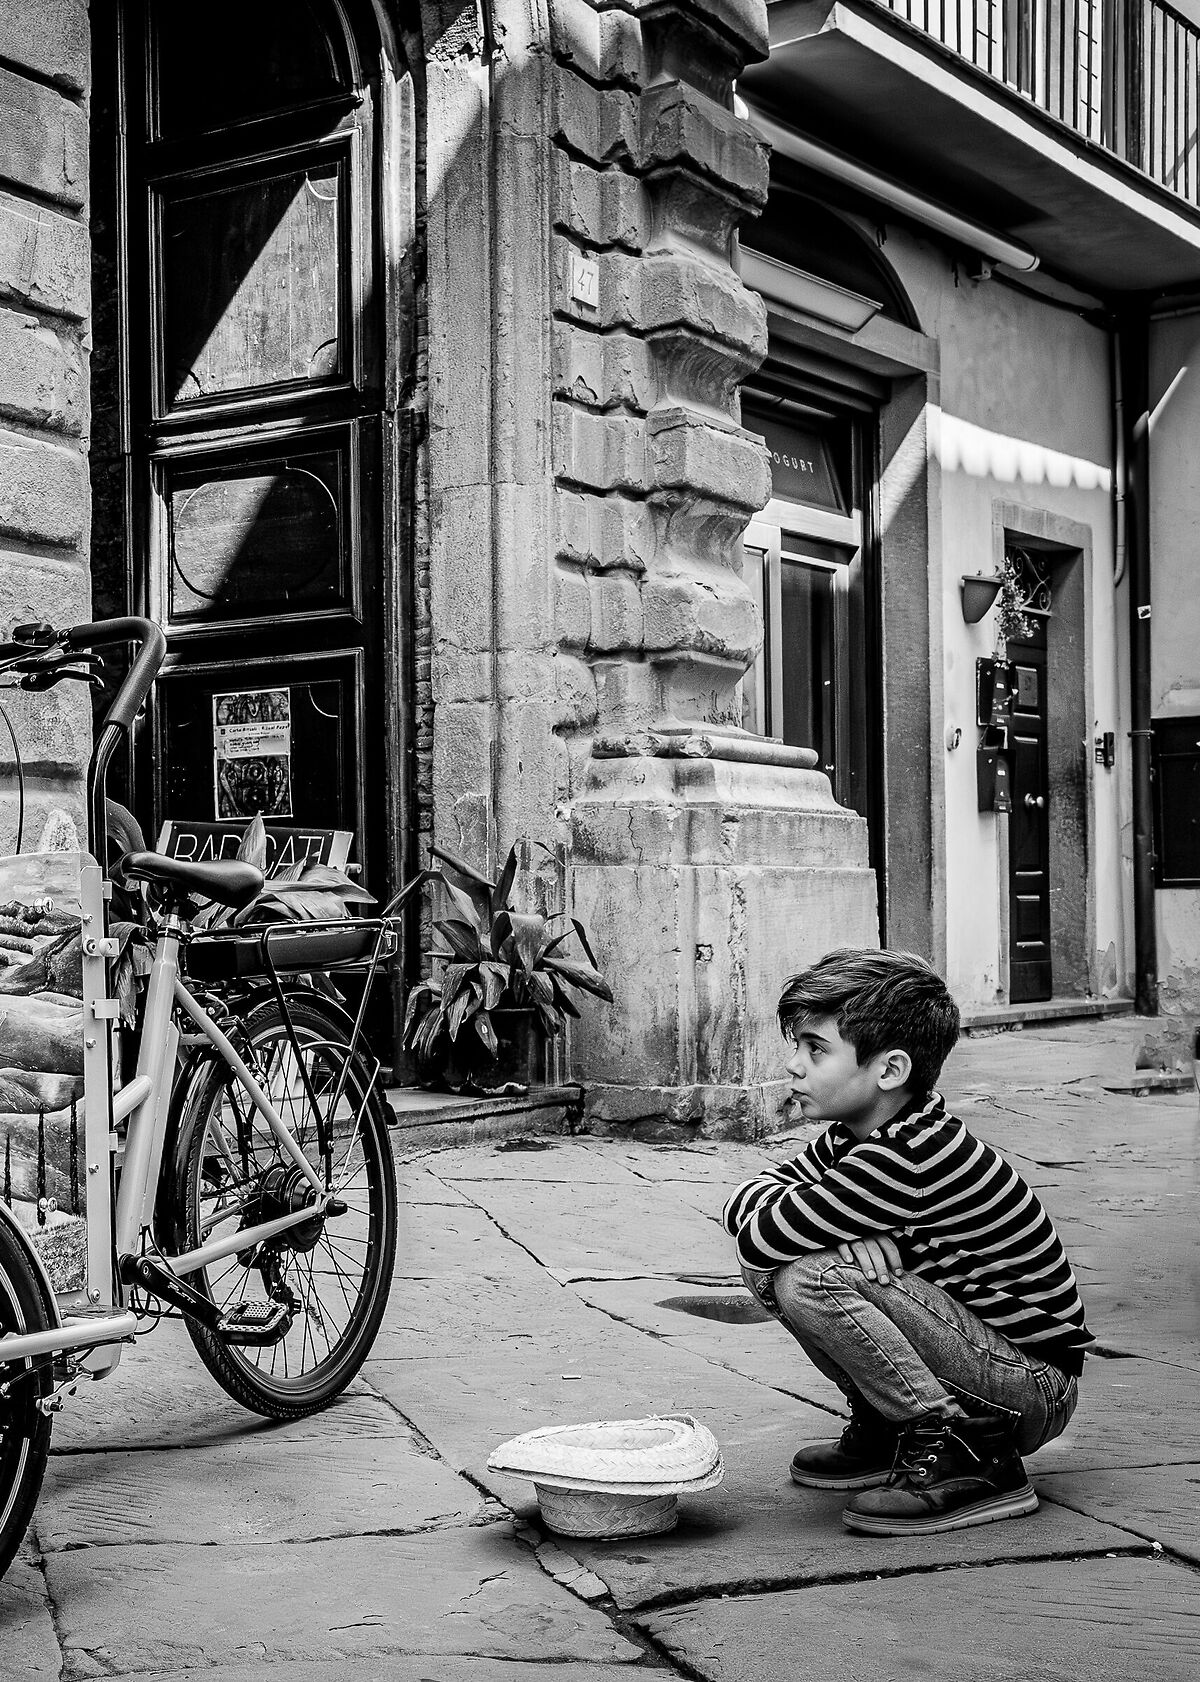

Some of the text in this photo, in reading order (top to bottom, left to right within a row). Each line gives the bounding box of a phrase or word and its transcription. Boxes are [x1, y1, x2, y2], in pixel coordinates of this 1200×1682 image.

[577, 268, 595, 296] 47
[772, 451, 814, 474] OGURT
[173, 833, 325, 880] RADCATI
